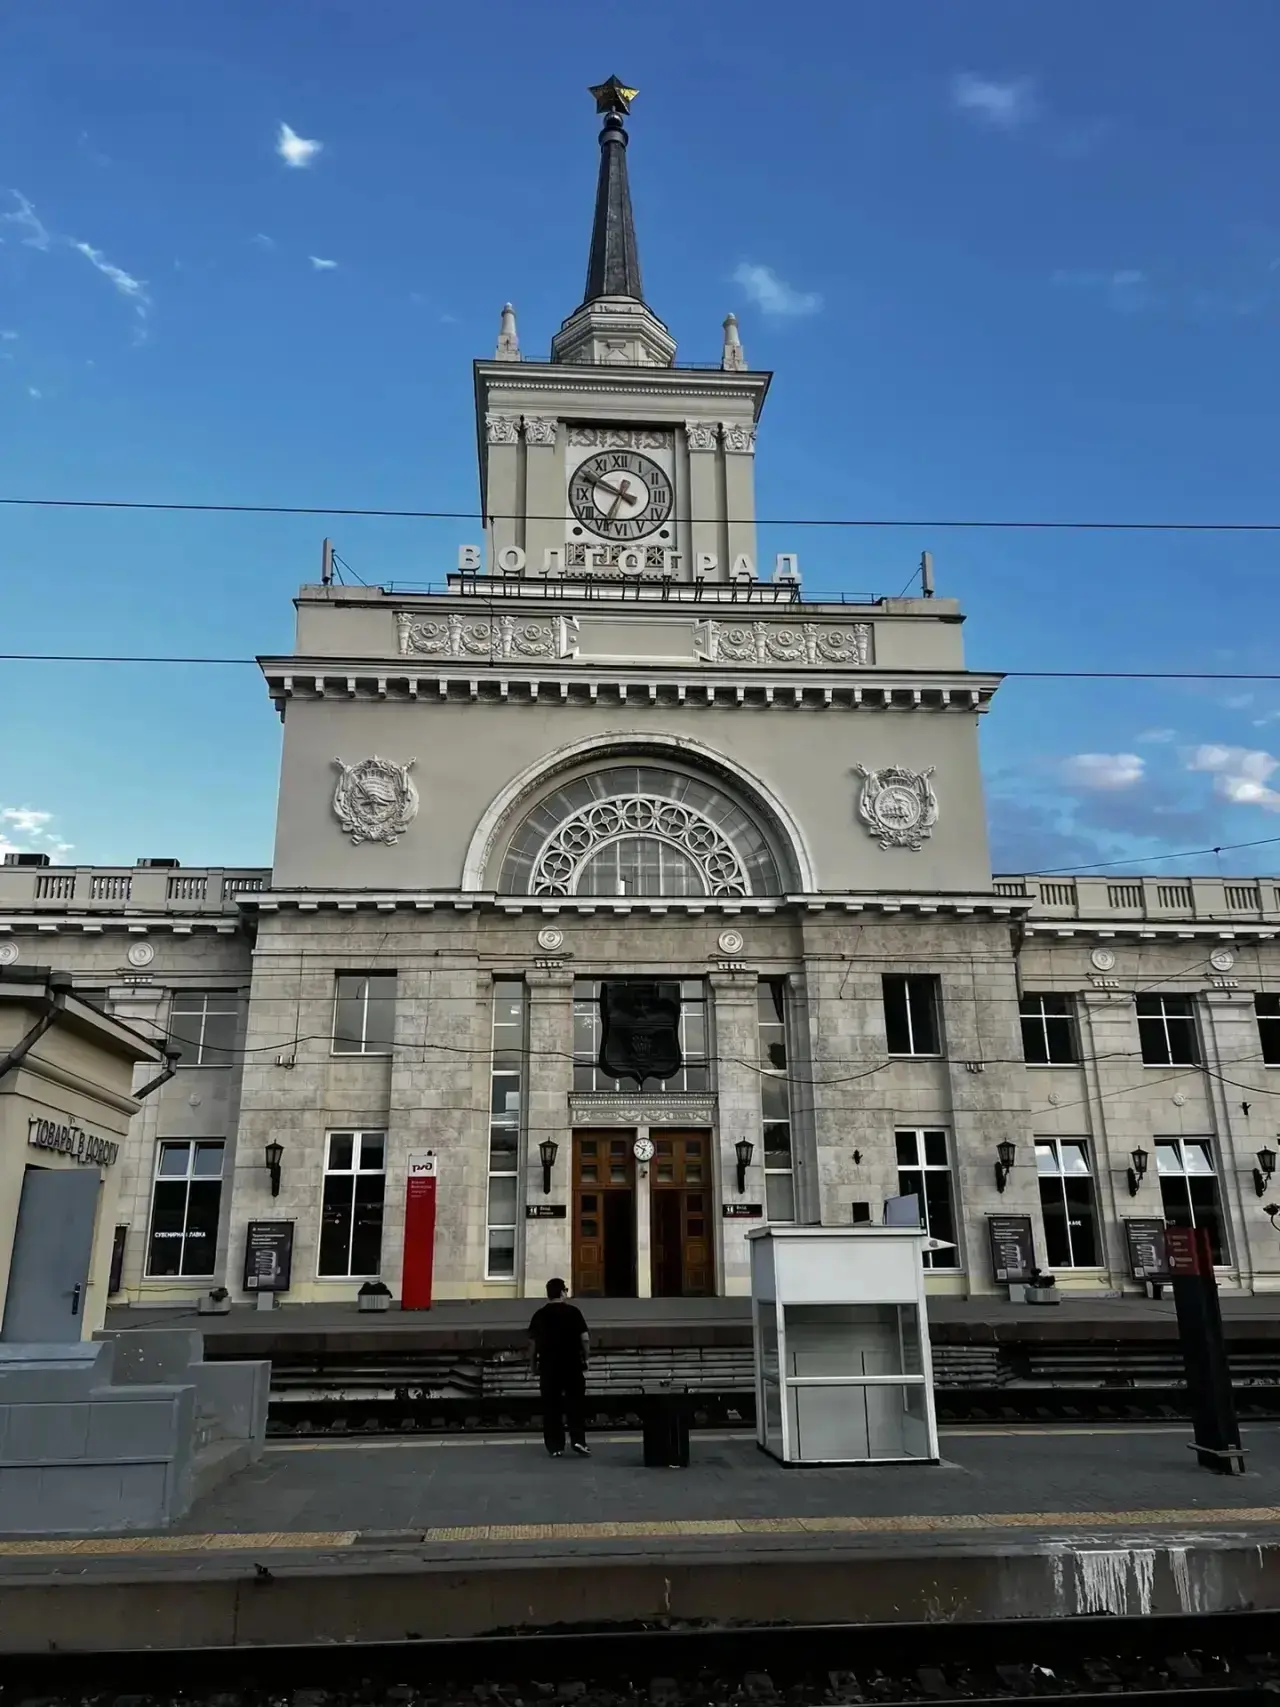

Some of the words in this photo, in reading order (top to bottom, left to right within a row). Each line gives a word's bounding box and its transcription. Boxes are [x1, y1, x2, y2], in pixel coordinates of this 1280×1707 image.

[594, 459, 607, 472] XI
[612, 455, 628, 468] XII
[638, 461, 642, 473] I
[651, 472, 659, 485] II
[576, 488, 589, 501] IX
[653, 490, 666, 503] III
[576, 506, 594, 519] VIII
[650, 508, 664, 520] IV
[614, 523, 628, 536] VI
[635, 519, 645, 533] V
[457, 544, 802, 583] ВОЛГОГРАД
[86, 1134, 120, 1165] ДОРОГУ
